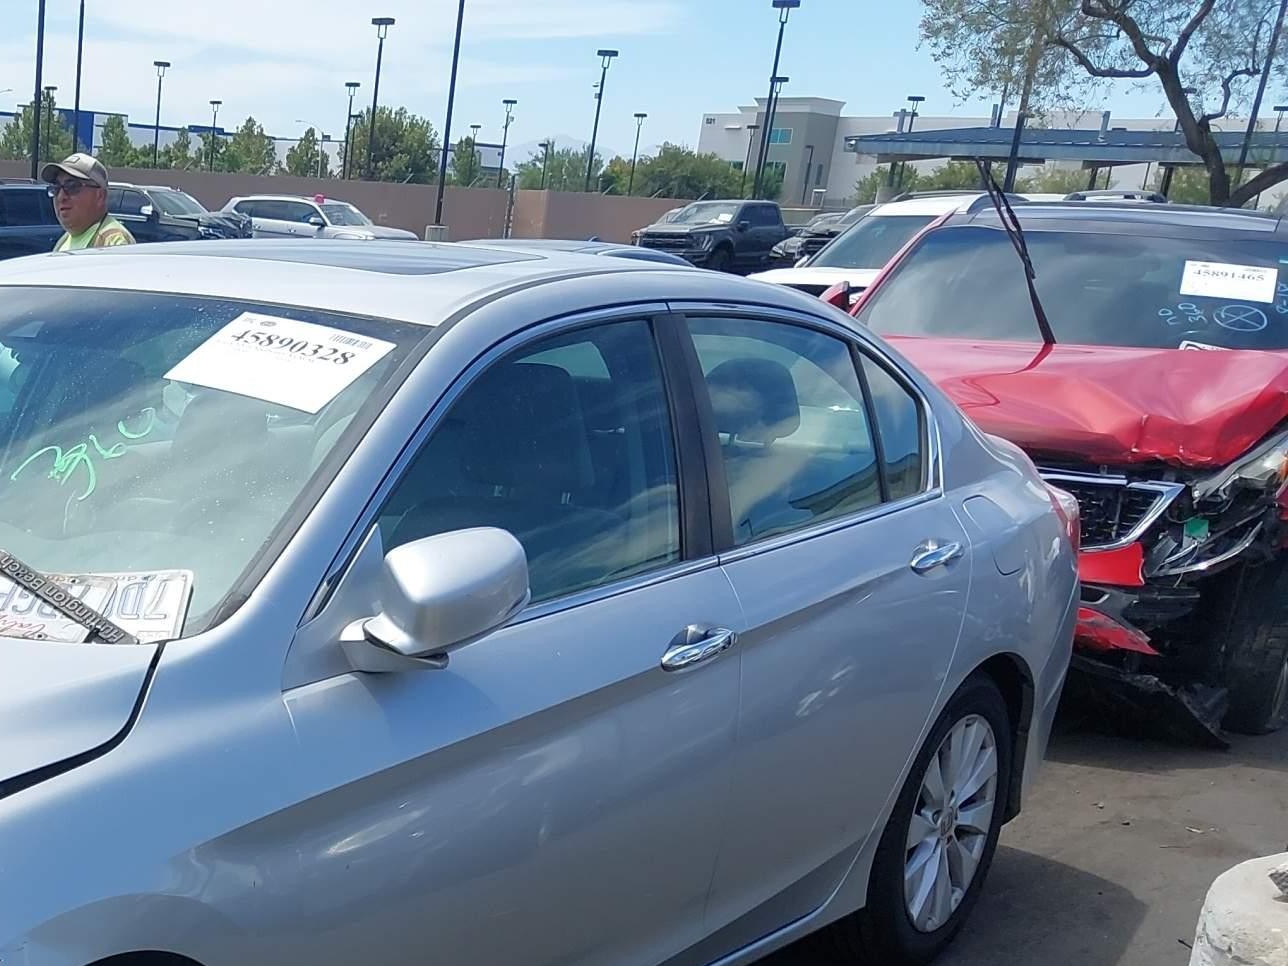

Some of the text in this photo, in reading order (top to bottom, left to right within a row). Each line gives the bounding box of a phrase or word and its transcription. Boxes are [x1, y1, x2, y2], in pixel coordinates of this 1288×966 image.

[232, 329, 357, 366] 45890328
[0, 556, 126, 644] Huntington Beach
